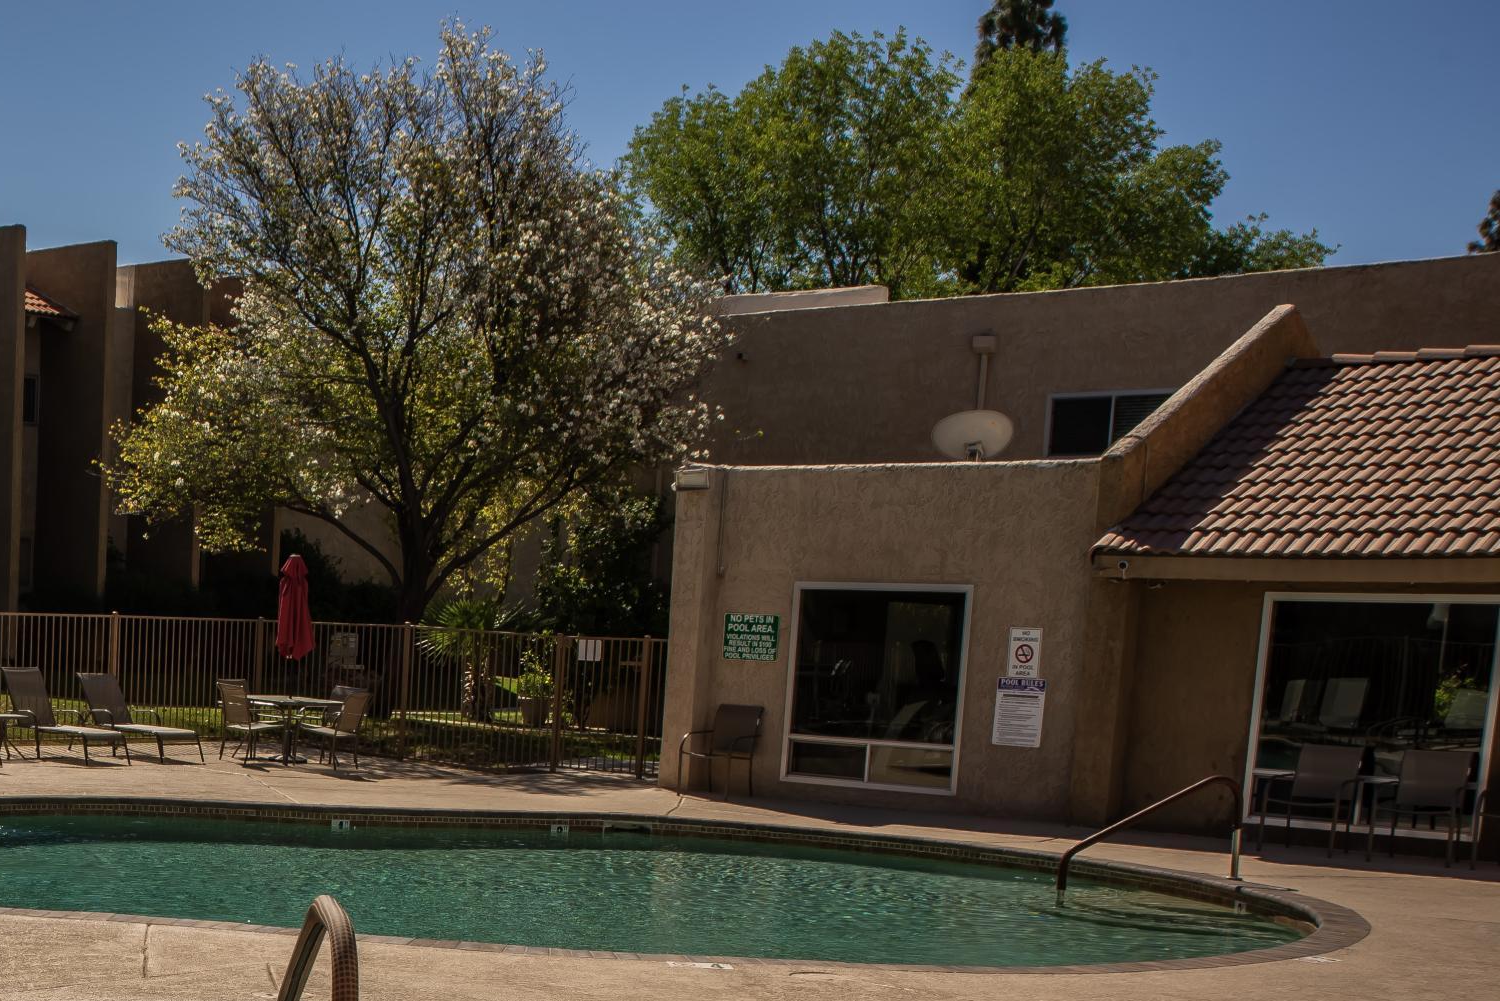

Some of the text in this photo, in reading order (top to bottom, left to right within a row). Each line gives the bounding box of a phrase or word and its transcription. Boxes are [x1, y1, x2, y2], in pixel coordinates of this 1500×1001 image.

[730, 614, 774, 624] NO PETS IN
[728, 623, 749, 631] POOL
[1021, 679, 1044, 687] RULES
